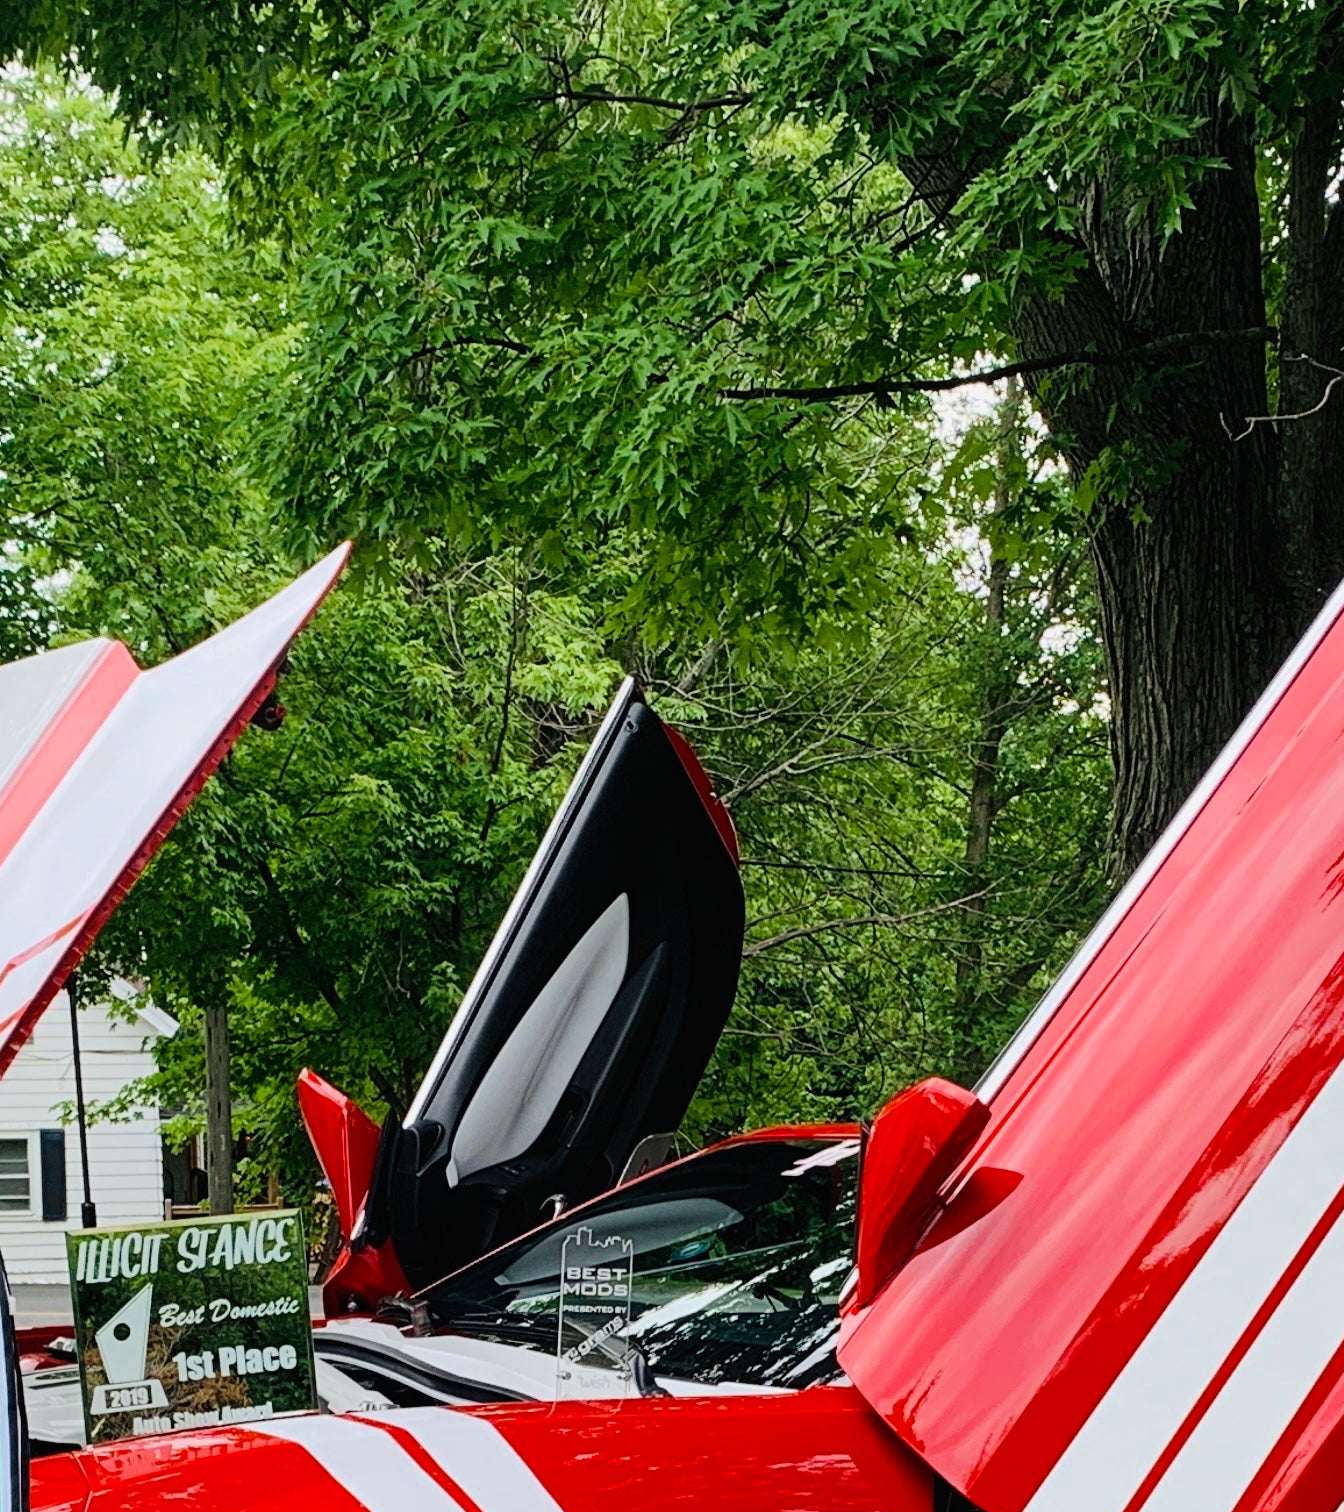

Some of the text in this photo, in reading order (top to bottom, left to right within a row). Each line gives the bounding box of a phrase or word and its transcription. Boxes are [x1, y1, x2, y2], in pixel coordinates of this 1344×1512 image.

[76, 1218, 294, 1283] ILLICIT STANCE
[567, 1267, 627, 1281] BEST
[564, 1283, 628, 1296] MODS
[158, 1297, 300, 1328] Best Domestic
[564, 1305, 627, 1314] PRESENTED BY
[172, 1344, 297, 1382] 1st Place
[110, 1387, 149, 1408] 2019
[133, 1401, 273, 1435] Auto Show Award
